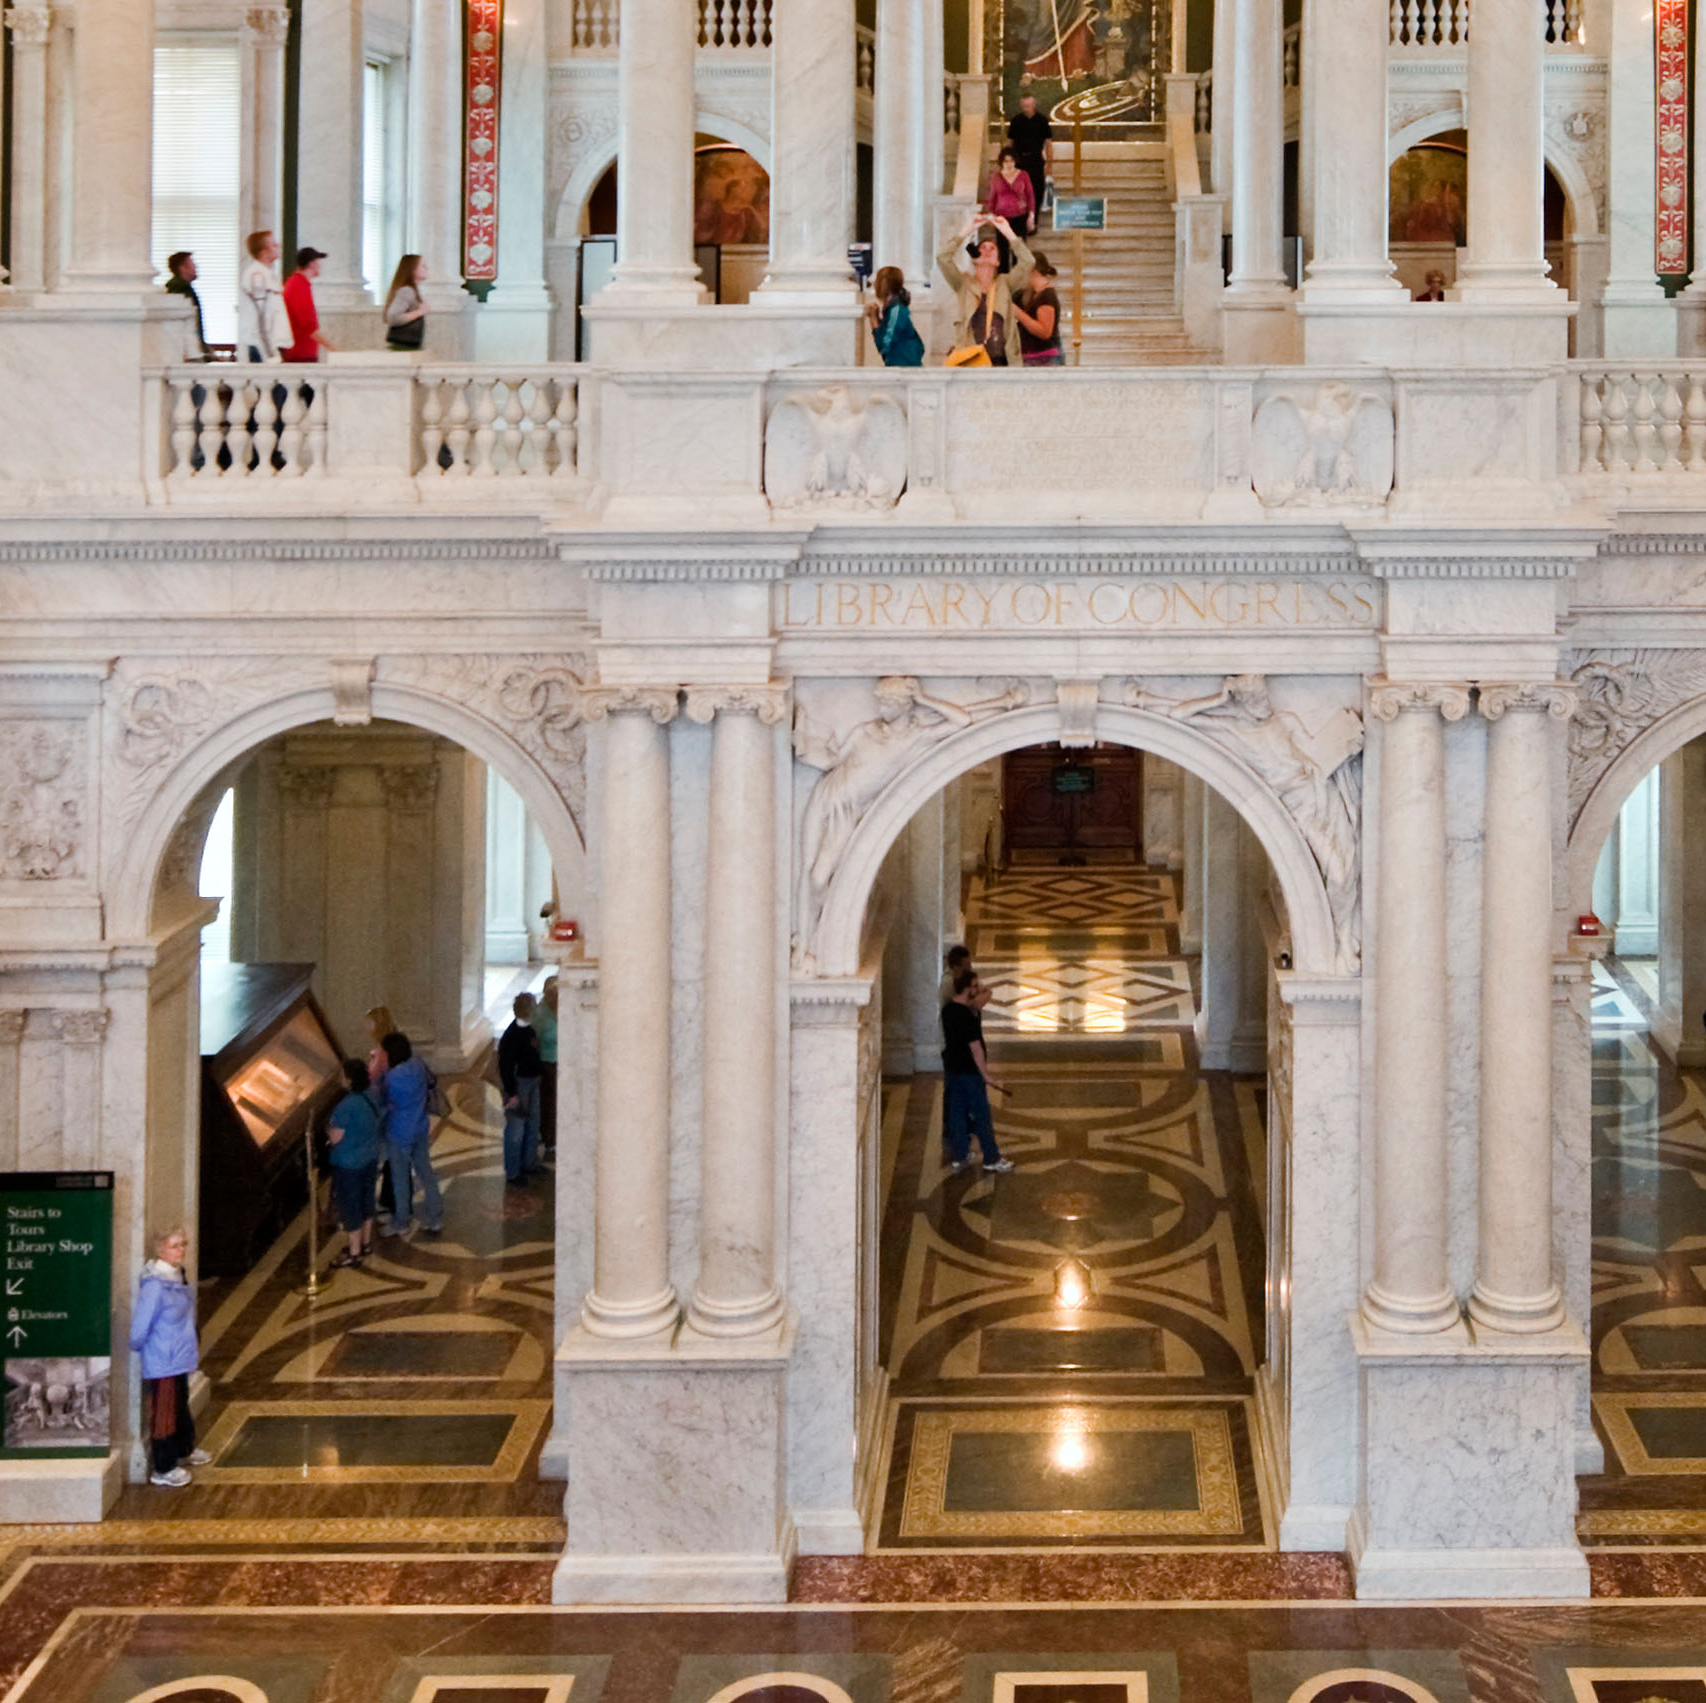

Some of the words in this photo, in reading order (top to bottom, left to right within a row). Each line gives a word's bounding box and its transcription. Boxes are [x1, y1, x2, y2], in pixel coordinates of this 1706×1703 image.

[782, 582, 999, 627] LIBRARY
[1010, 582, 1078, 627] OF
[1088, 581, 1375, 626] CONGRESS
[7, 1206, 45, 1219] Stairs
[47, 1207, 62, 1219] to
[6, 1222, 46, 1236] Tours
[6, 1239, 56, 1256] Library
[58, 1238, 94, 1256] Shop
[6, 1256, 34, 1270] Exit
[20, 1308, 69, 1321] Elevators
